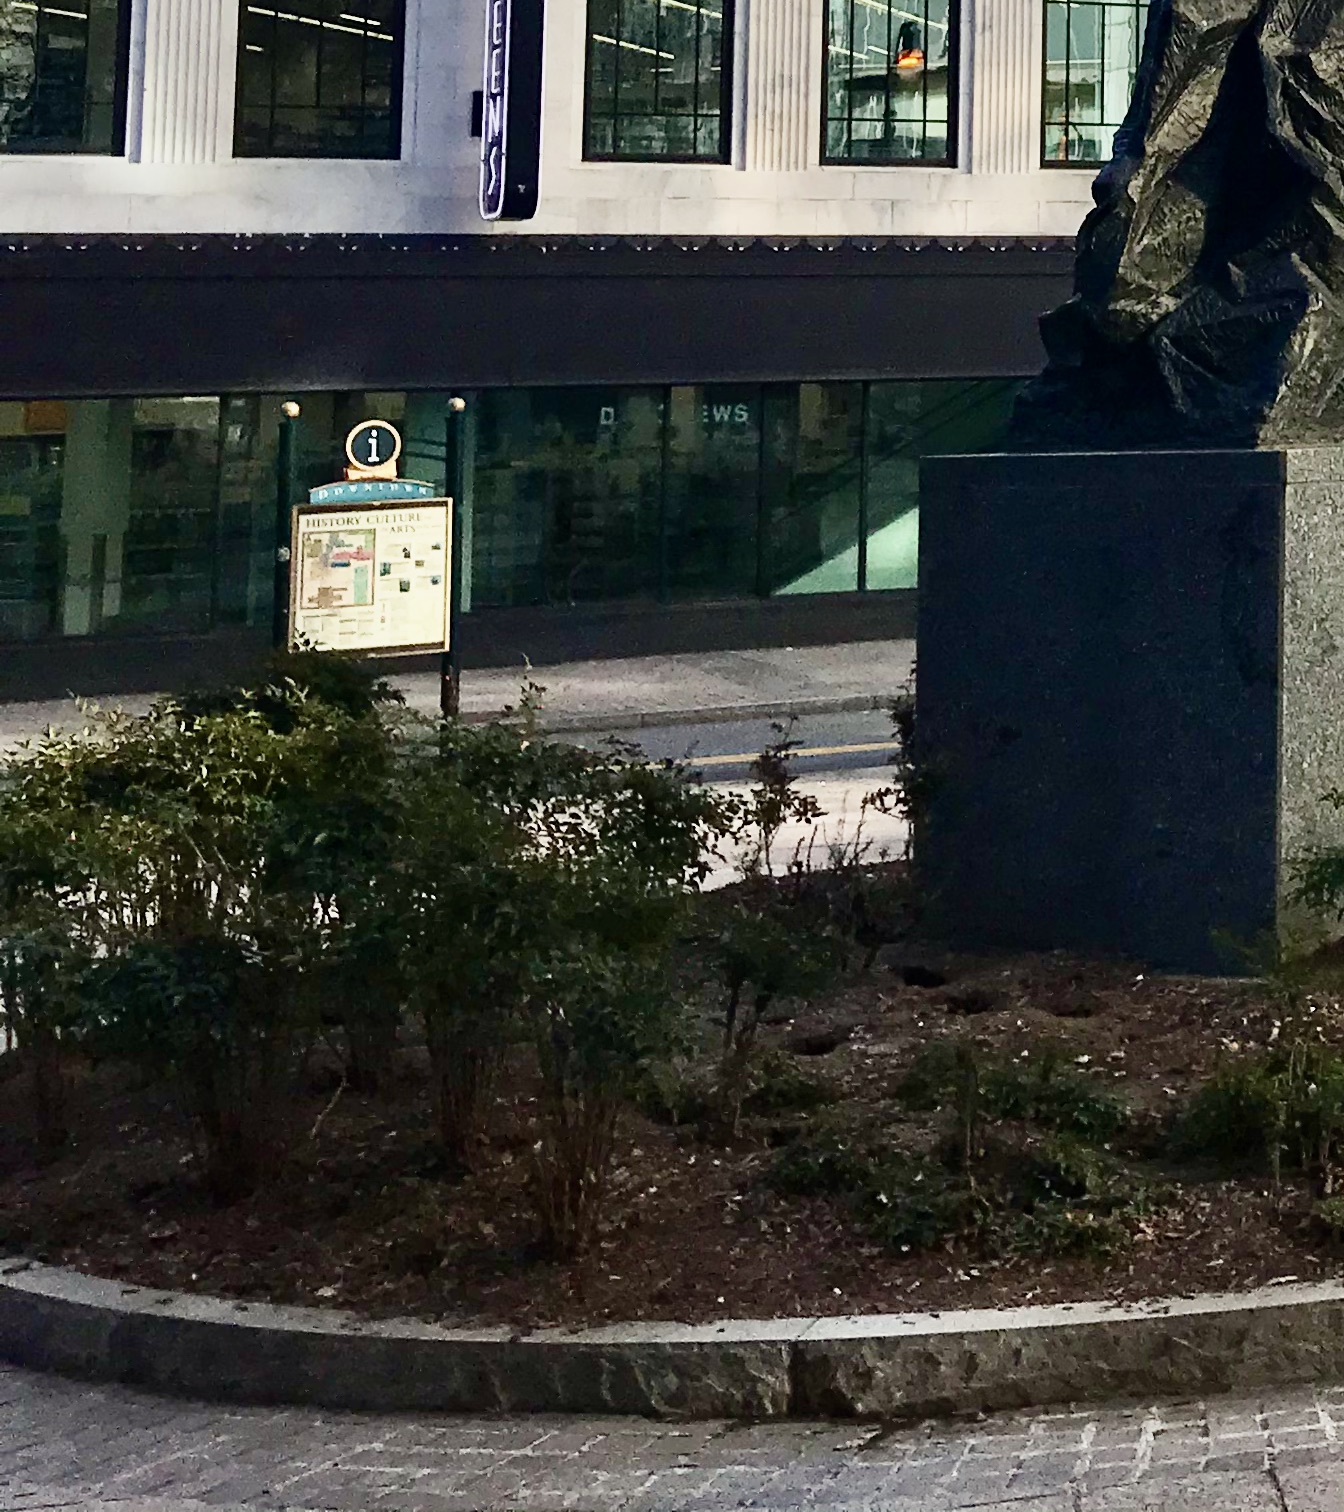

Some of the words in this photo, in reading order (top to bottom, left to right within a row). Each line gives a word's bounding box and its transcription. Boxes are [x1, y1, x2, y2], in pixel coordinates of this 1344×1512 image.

[318, 482, 428, 501] DOWNTOWN
[306, 515, 362, 529] HISTORY
[389, 524, 416, 534] ARTS
